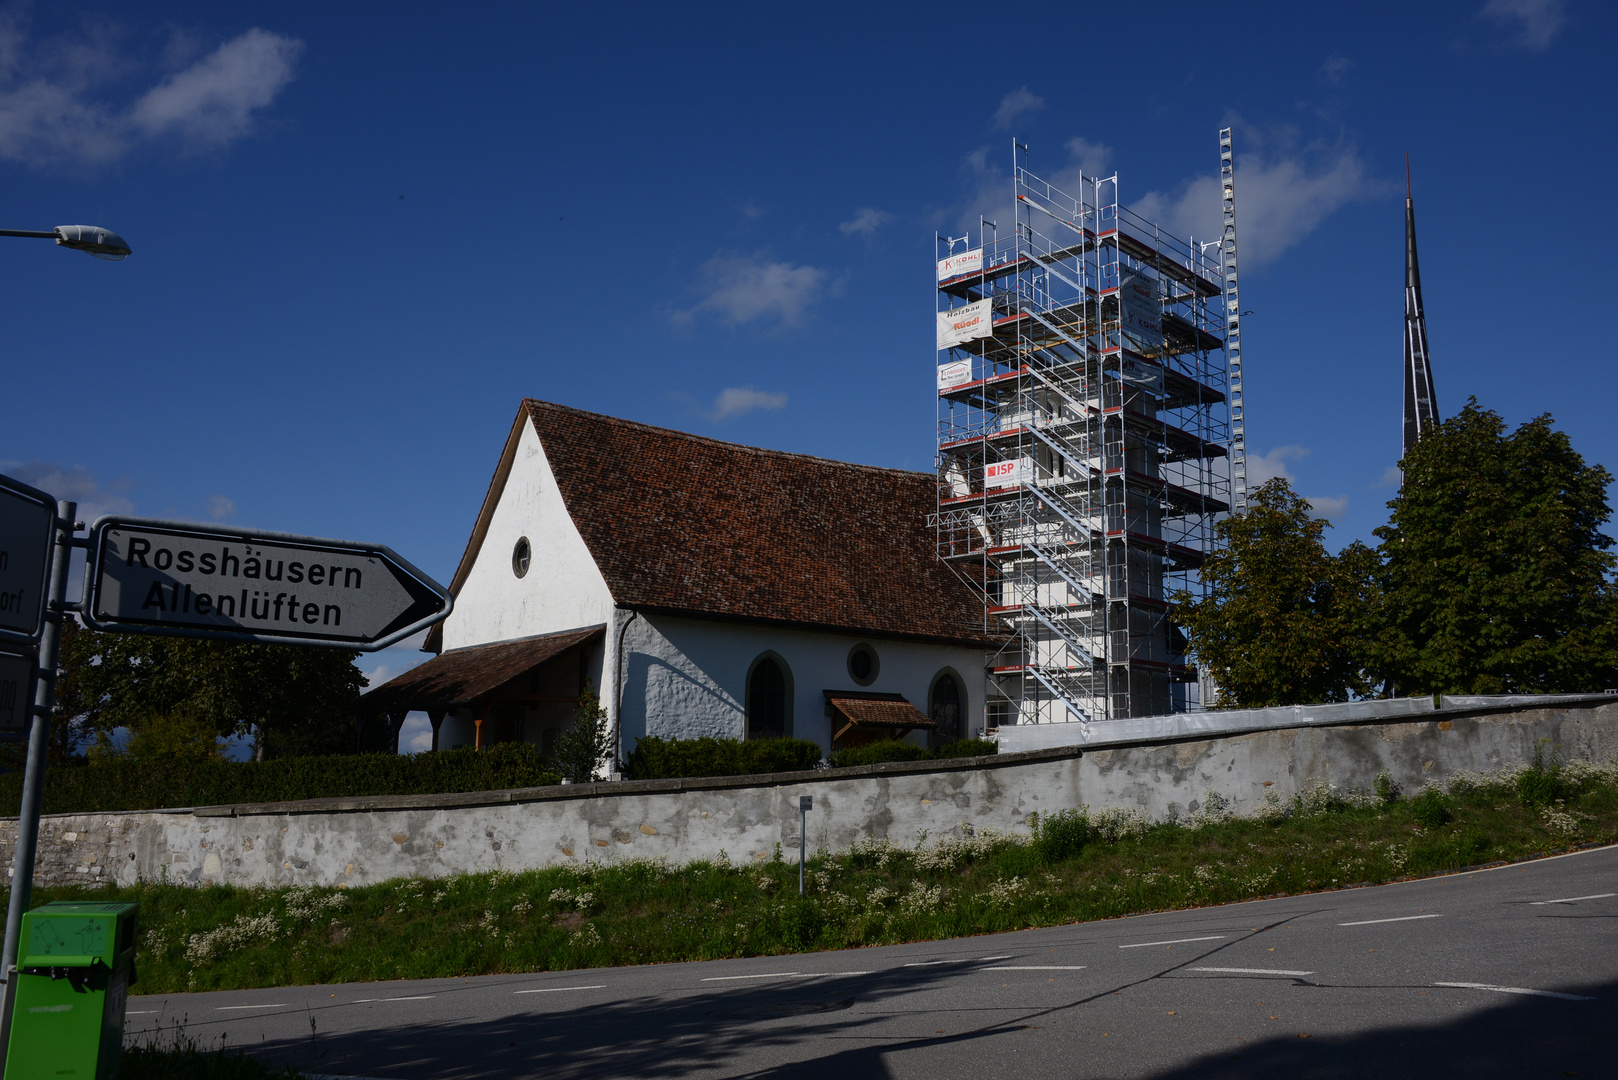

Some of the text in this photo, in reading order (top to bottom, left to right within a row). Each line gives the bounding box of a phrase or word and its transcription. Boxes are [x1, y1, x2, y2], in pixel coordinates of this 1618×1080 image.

[956, 253, 981, 263] KOHLI
[947, 304, 980, 318] Holzbau
[1138, 319, 1161, 333] KOHLI
[997, 463, 1014, 475] ISP
[126, 537, 362, 589] Rosshäusern
[142, 580, 343, 626] Allenlüften
